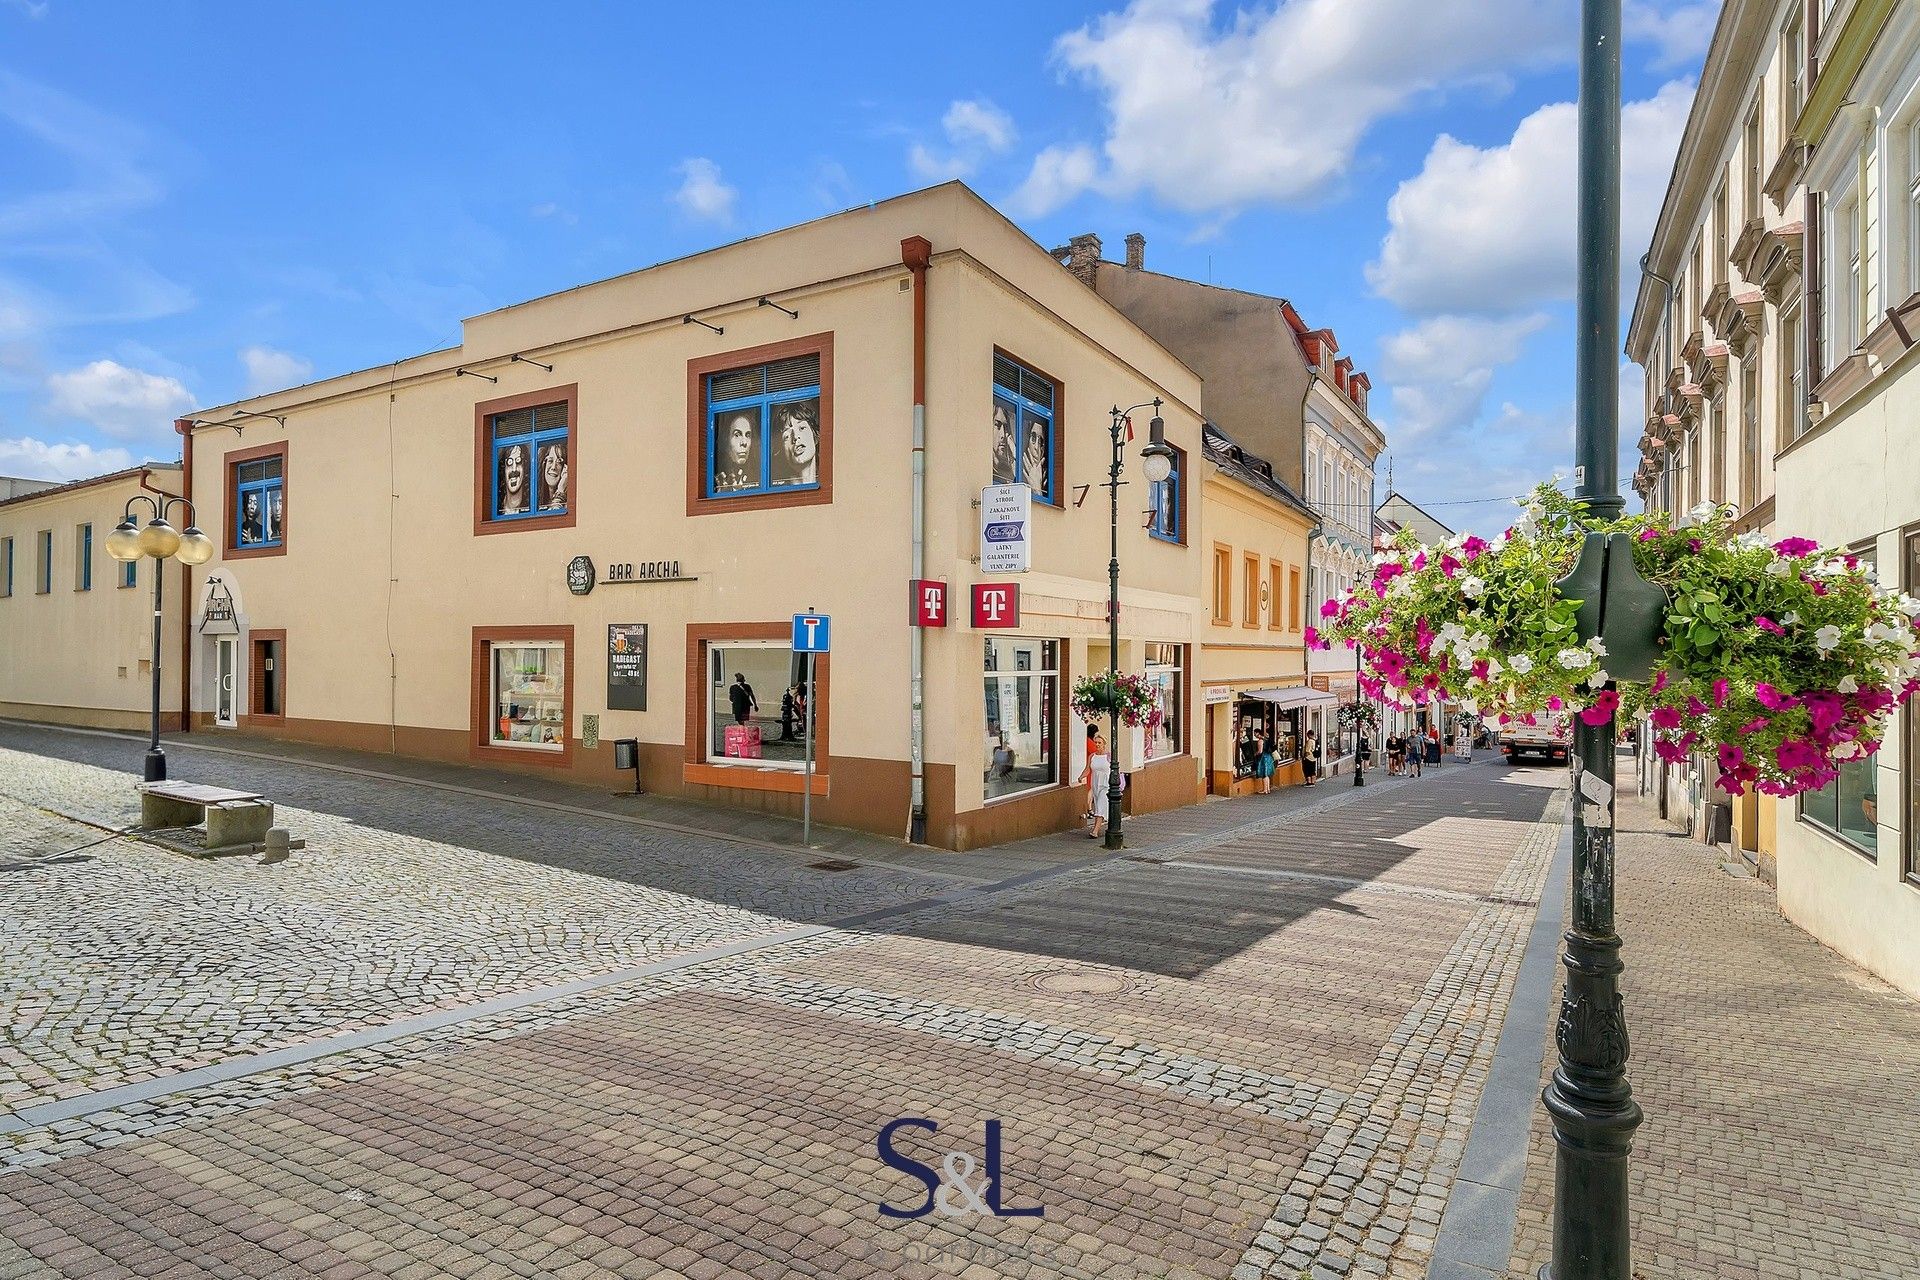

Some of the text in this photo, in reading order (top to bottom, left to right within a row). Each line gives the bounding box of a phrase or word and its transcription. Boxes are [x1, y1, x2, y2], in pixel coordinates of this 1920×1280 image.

[609, 560, 680, 579] BAR ARCHA
[925, 588, 941, 619] T
[983, 591, 1005, 620] T
[613, 655, 640, 663] RADEGAST
